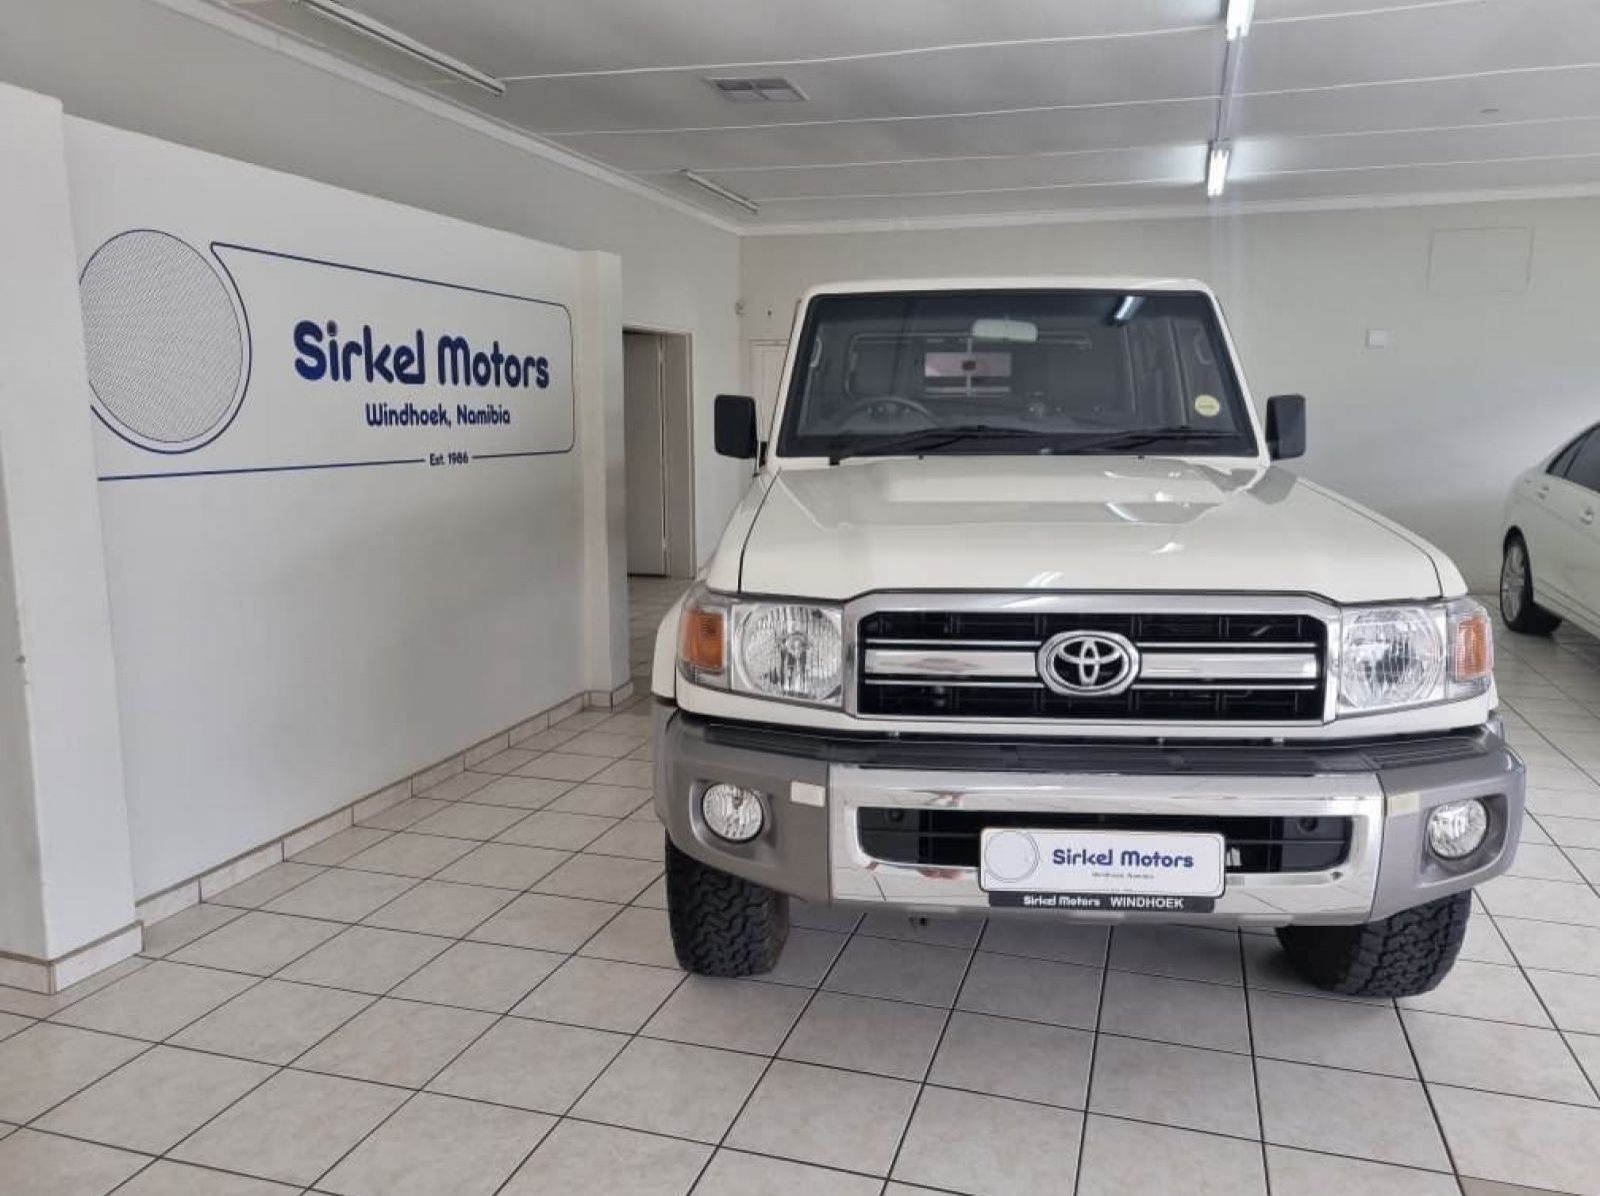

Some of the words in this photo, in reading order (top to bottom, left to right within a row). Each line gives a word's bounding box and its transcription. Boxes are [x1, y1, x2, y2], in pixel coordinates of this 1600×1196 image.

[293, 319, 426, 385] Sirkel
[437, 335, 550, 389] Motors
[366, 403, 451, 428] Windhoek,
[457, 404, 511, 425] Namibia
[448, 451, 469, 465] 1986
[1053, 849, 1113, 867] Sirkel
[1120, 850, 1194, 868] Motors
[1023, 895, 1056, 906] Sirkel
[1058, 896, 1101, 907] Motors
[1110, 896, 1184, 909] WINDHOEK
